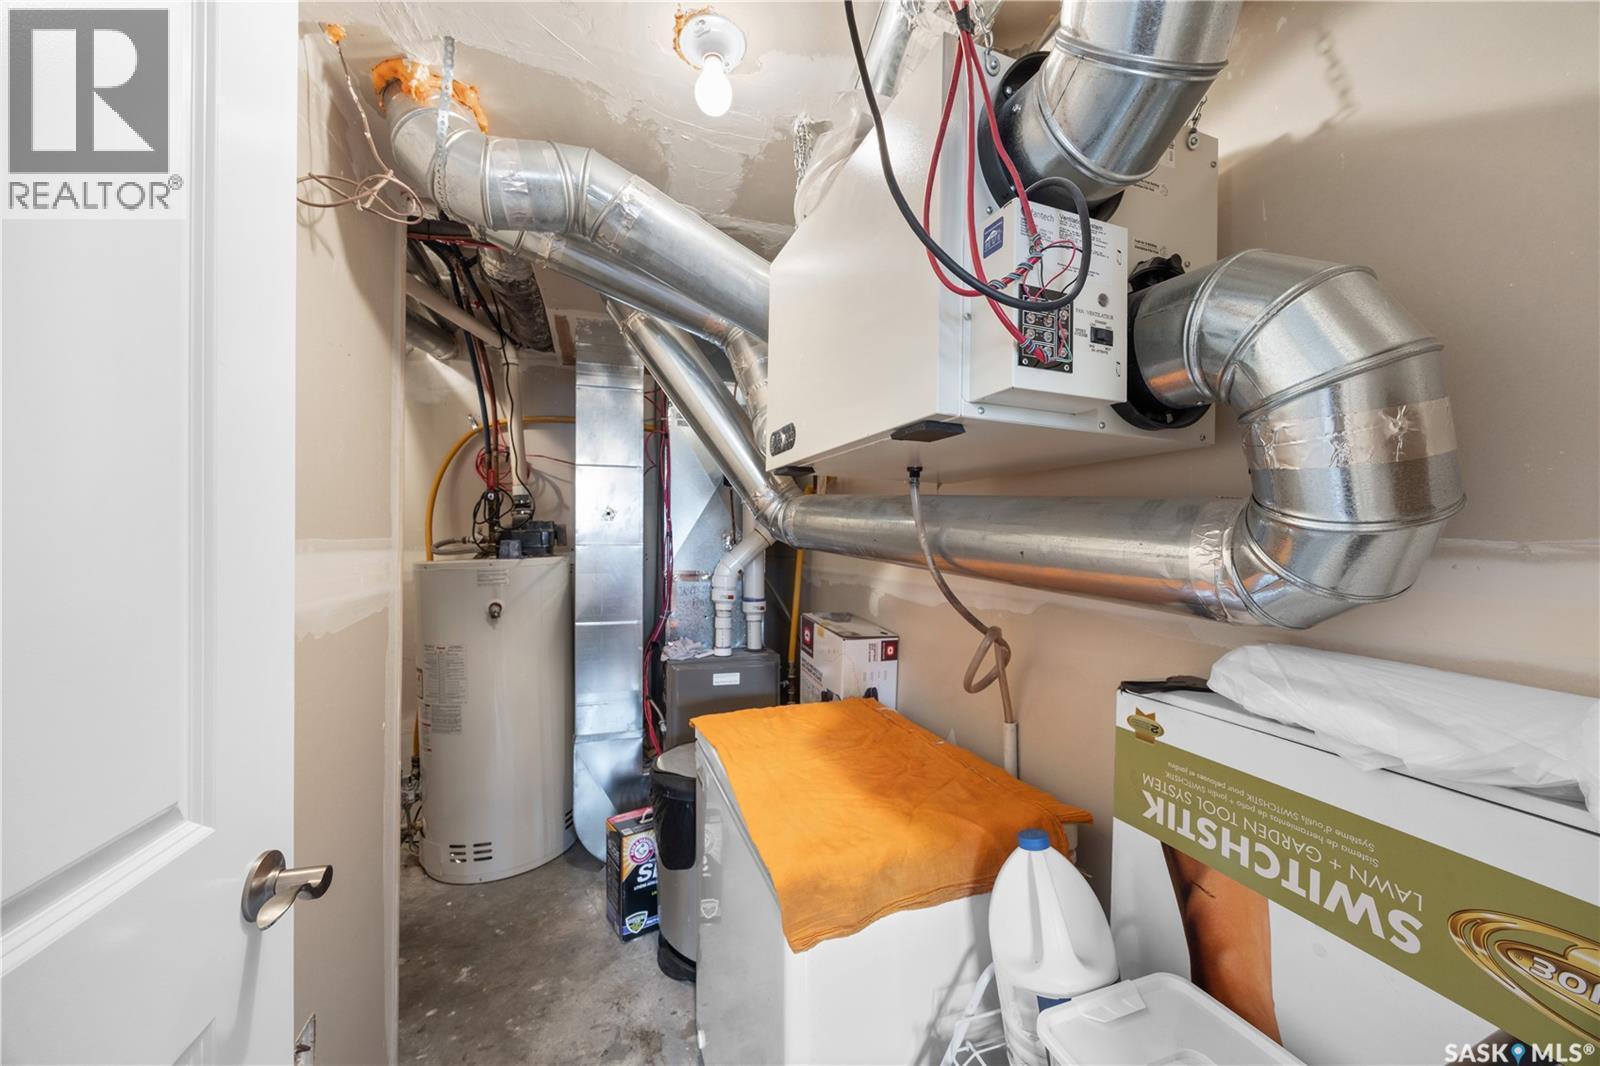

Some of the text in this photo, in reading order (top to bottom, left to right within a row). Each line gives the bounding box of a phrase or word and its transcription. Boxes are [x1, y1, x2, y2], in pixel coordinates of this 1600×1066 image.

[1165, 771, 1206, 793] SWITCHSTIK
[1246, 793, 1299, 821] SWITCHSTIK
[1142, 772, 1423, 912] LAWN + GARDEN TOOL SYSTEM
[1270, 813, 1324, 844] herramientas
[1326, 838, 1338, 849] de
[1341, 845, 1379, 868] Sistema
[1142, 789, 1423, 954] SWITCHSTIK
